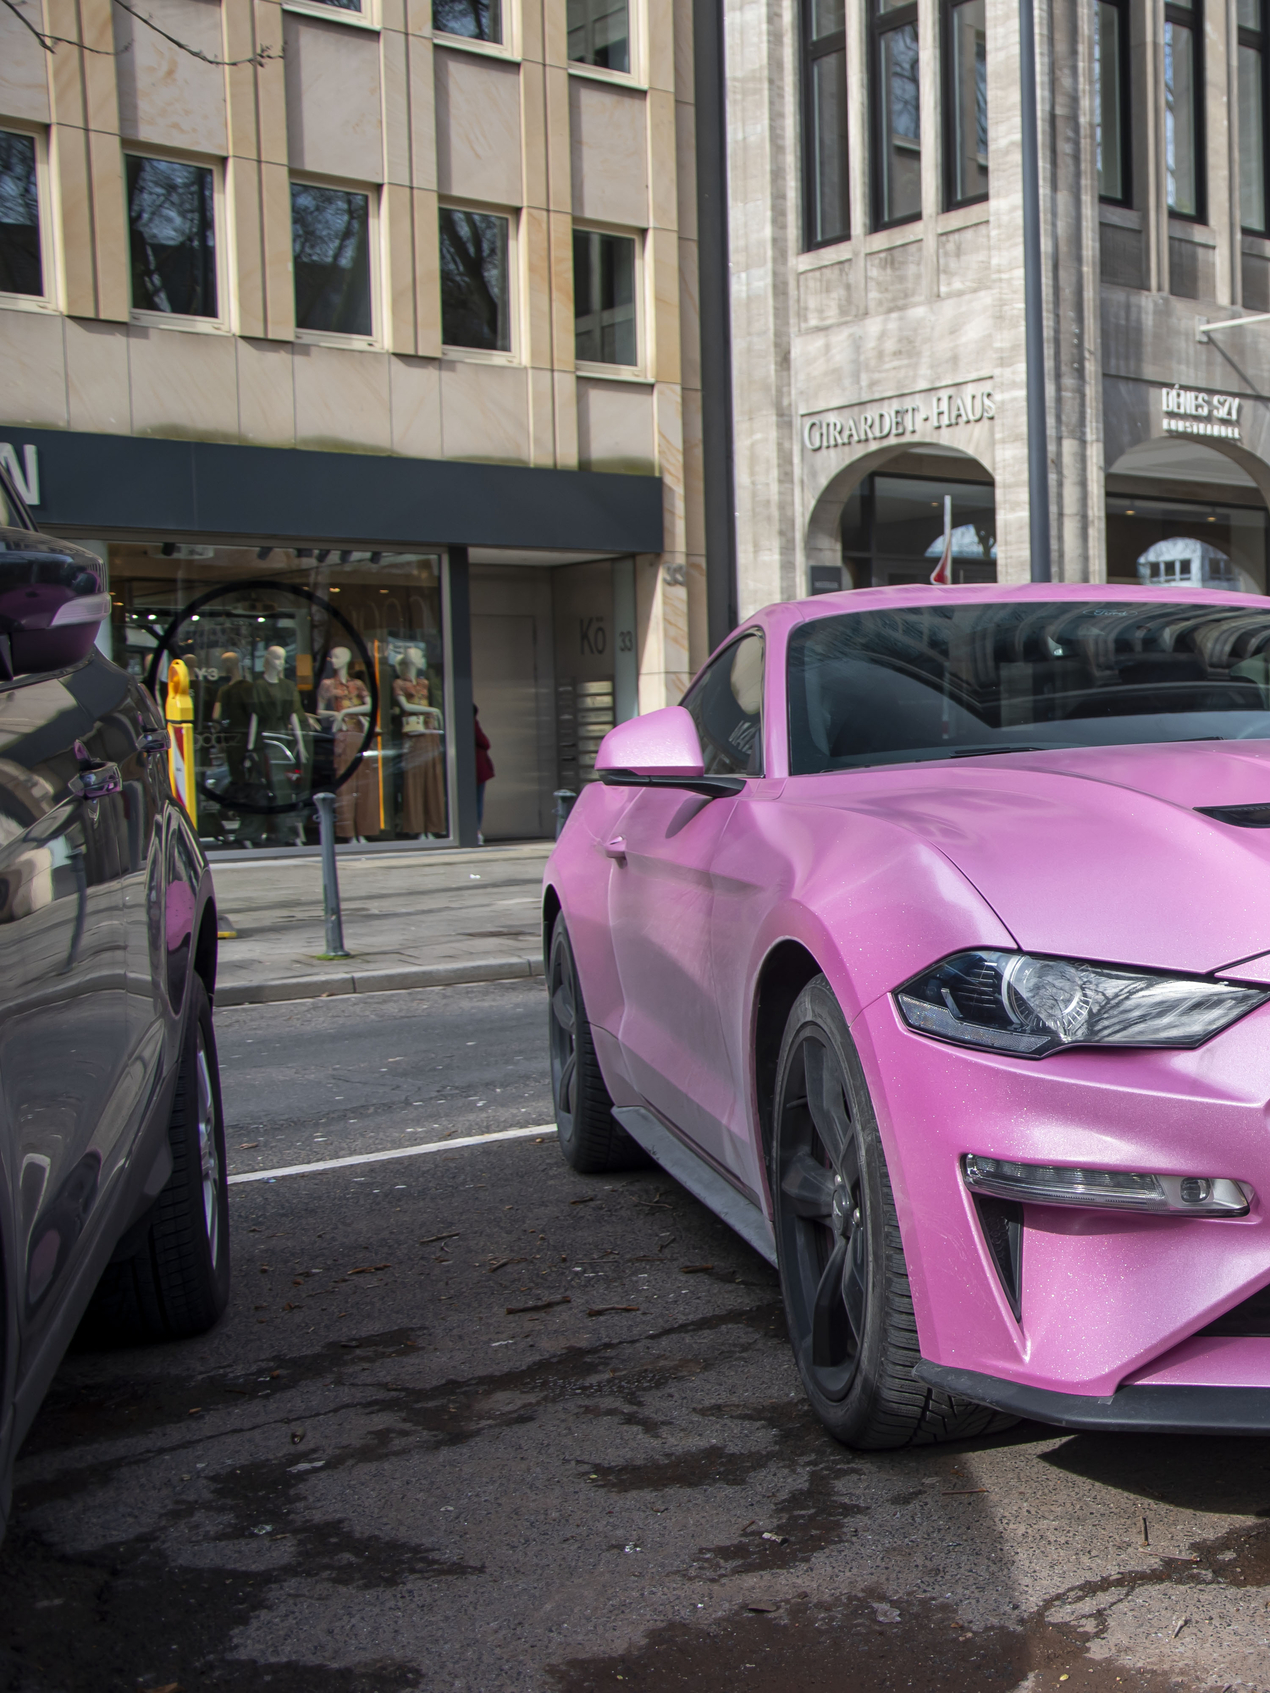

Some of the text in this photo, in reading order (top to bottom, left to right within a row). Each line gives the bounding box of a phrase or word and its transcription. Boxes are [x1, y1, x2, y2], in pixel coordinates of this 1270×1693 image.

[1162, 384, 1240, 421] DÉNES SZY
[662, 562, 687, 586] 33
[580, 617, 607, 655] Kö
[619, 631, 634, 652] 33
